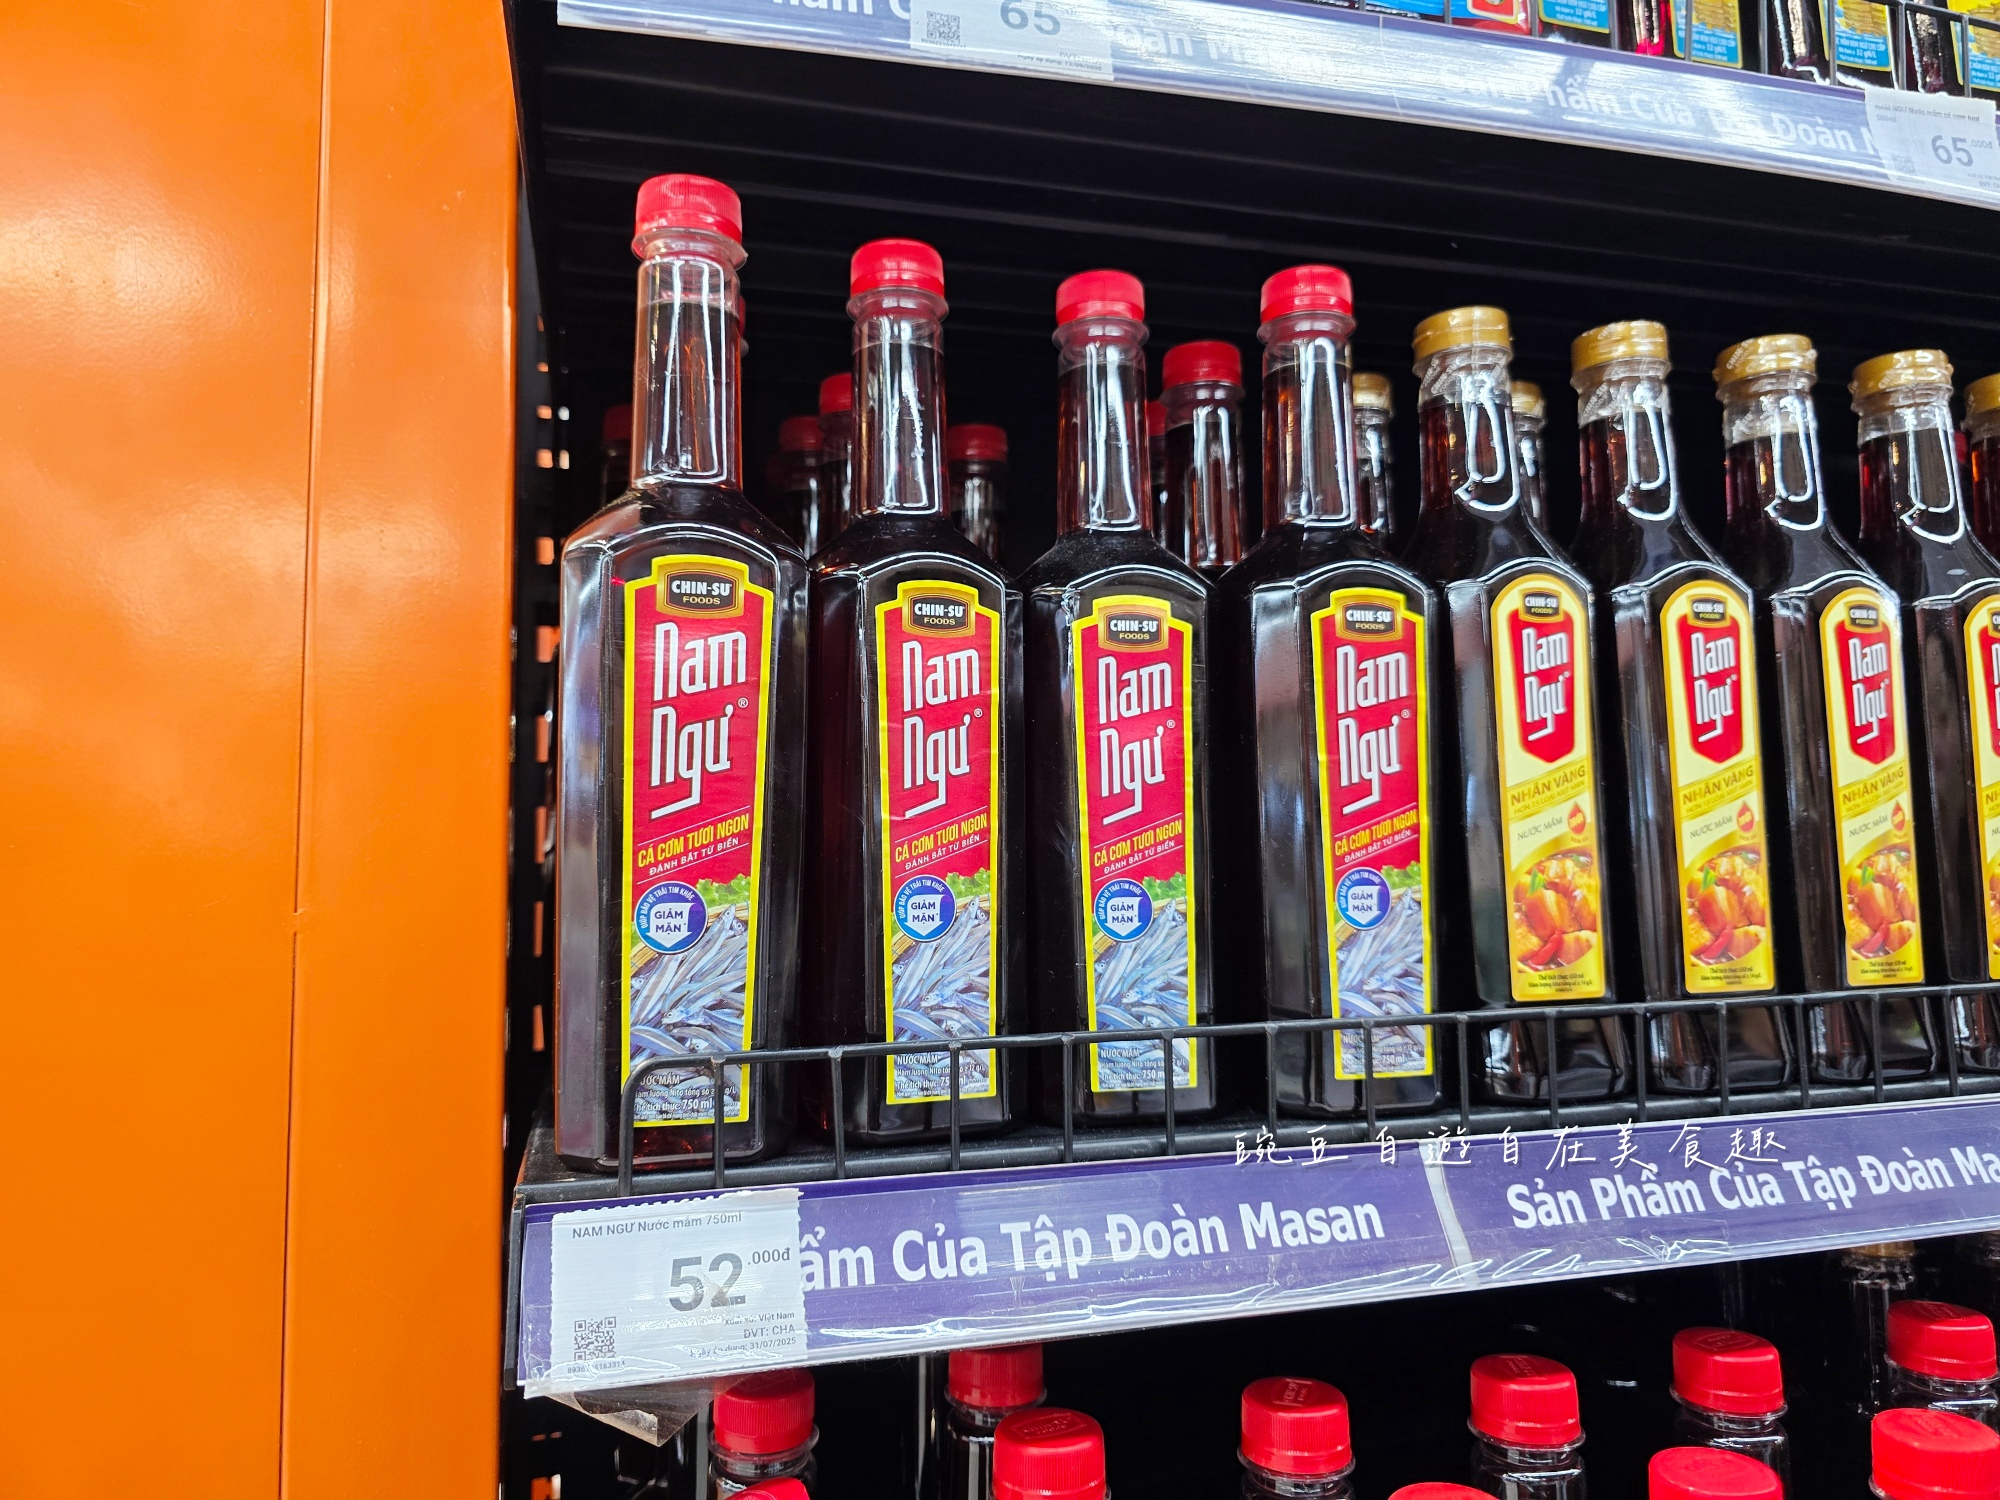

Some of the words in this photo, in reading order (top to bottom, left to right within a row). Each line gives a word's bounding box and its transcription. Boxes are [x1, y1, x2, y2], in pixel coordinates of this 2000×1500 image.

[1770, 111, 1857, 152] Đoàn
[1931, 134, 1974, 167] 65
[671, 580, 732, 596] CHIN-SU
[682, 595, 721, 605] FOODS
[1524, 595, 1558, 608] CHIN-SU
[914, 602, 965, 618] CHIN-SU
[1345, 609, 1393, 623] CHIN-SU
[923, 617, 956, 626] FOODS
[1109, 619, 1159, 633] CHIN-SU
[1355, 622, 1385, 631] FOODS
[1119, 632, 1150, 640] FOODS
[1521, 627, 1569, 675] Nam
[1690, 632, 1737, 678] Nam
[653, 621, 747, 701] Nam
[1848, 637, 1889, 682] Nam
[902, 640, 980, 713] Nam
[1336, 644, 1410, 715] Nam
[1098, 655, 1173, 725] Nam
[1510, 780, 1551, 807] NHÃN
[1552, 764, 1586, 788] VÀNG
[1682, 780, 1721, 806] NHÃN
[1722, 765, 1754, 788] VÀNG
[1842, 779, 1878, 806] NHÃN
[1879, 766, 1905, 788] VÀNG
[895, 841, 910, 863] CÁ
[911, 837, 934, 856] CƠM
[936, 824, 959, 846] TƯƠI
[961, 812, 988, 837] NGON
[1334, 836, 1349, 856] CÁ
[1349, 829, 1371, 850] CƠM
[1371, 818, 1393, 841] TƯƠI
[1393, 808, 1419, 832] NGON
[1517, 824, 1542, 841] NƯỚC
[638, 843, 655, 868] CÁ
[657, 836, 685, 861] CƠM
[687, 824, 714, 850] TƯƠI
[717, 813, 750, 840] NGON
[1093, 846, 1108, 867] CÁ
[1109, 839, 1131, 861] CƠM
[1132, 829, 1154, 850] TƯƠI
[1156, 818, 1182, 842] NGON
[904, 854, 929, 870] ĐÁNH
[1343, 848, 1367, 863] ĐÁNH
[649, 858, 678, 876] ĐÁNH
[1103, 859, 1127, 874] ĐÁNH
[1350, 890, 1373, 900] GIẢM
[910, 899, 936, 910] GIẢM
[1110, 901, 1134, 912] GIẢM
[654, 907, 684, 920] GIẢM
[1381, 1054, 1395, 1064] 750
[1396, 1053, 1405, 1064] ml
[1142, 1069, 1156, 1079] 750
[681, 1098, 699, 1110] 750
[700, 1098, 713, 1109] ml
[1506, 1176, 1587, 1230] Sản
[1593, 1162, 1707, 1222] Phẩm
[1708, 1162, 1780, 1212] Của
[1776, 1158, 1858, 1212] Tập
[1859, 1149, 1956, 1197] Đoàn
[572, 1225, 603, 1239] NAM
[606, 1221, 636, 1236] NGƯ
[637, 1217, 670, 1233] Nước
[672, 1214, 702, 1230] mắm
[705, 1211, 743, 1226] 750ml
[800, 1226, 876, 1291] ẩm
[892, 1222, 987, 1283] Của
[1000, 1214, 1092, 1282] Tập
[1105, 1203, 1228, 1262] Đoàn
[1238, 1201, 1386, 1251] Masan
[668, 1252, 747, 1312] 52
[747, 1247, 791, 1266] .000đ
[758, 1312, 775, 1322] Việt
[776, 1312, 795, 1320] Nam
[743, 1327, 769, 1339] ĐVT:
[771, 1323, 796, 1336] CHA
[749, 1337, 797, 1350] 31/07/2025
[567, 1360, 626, 1374] 89366163314
